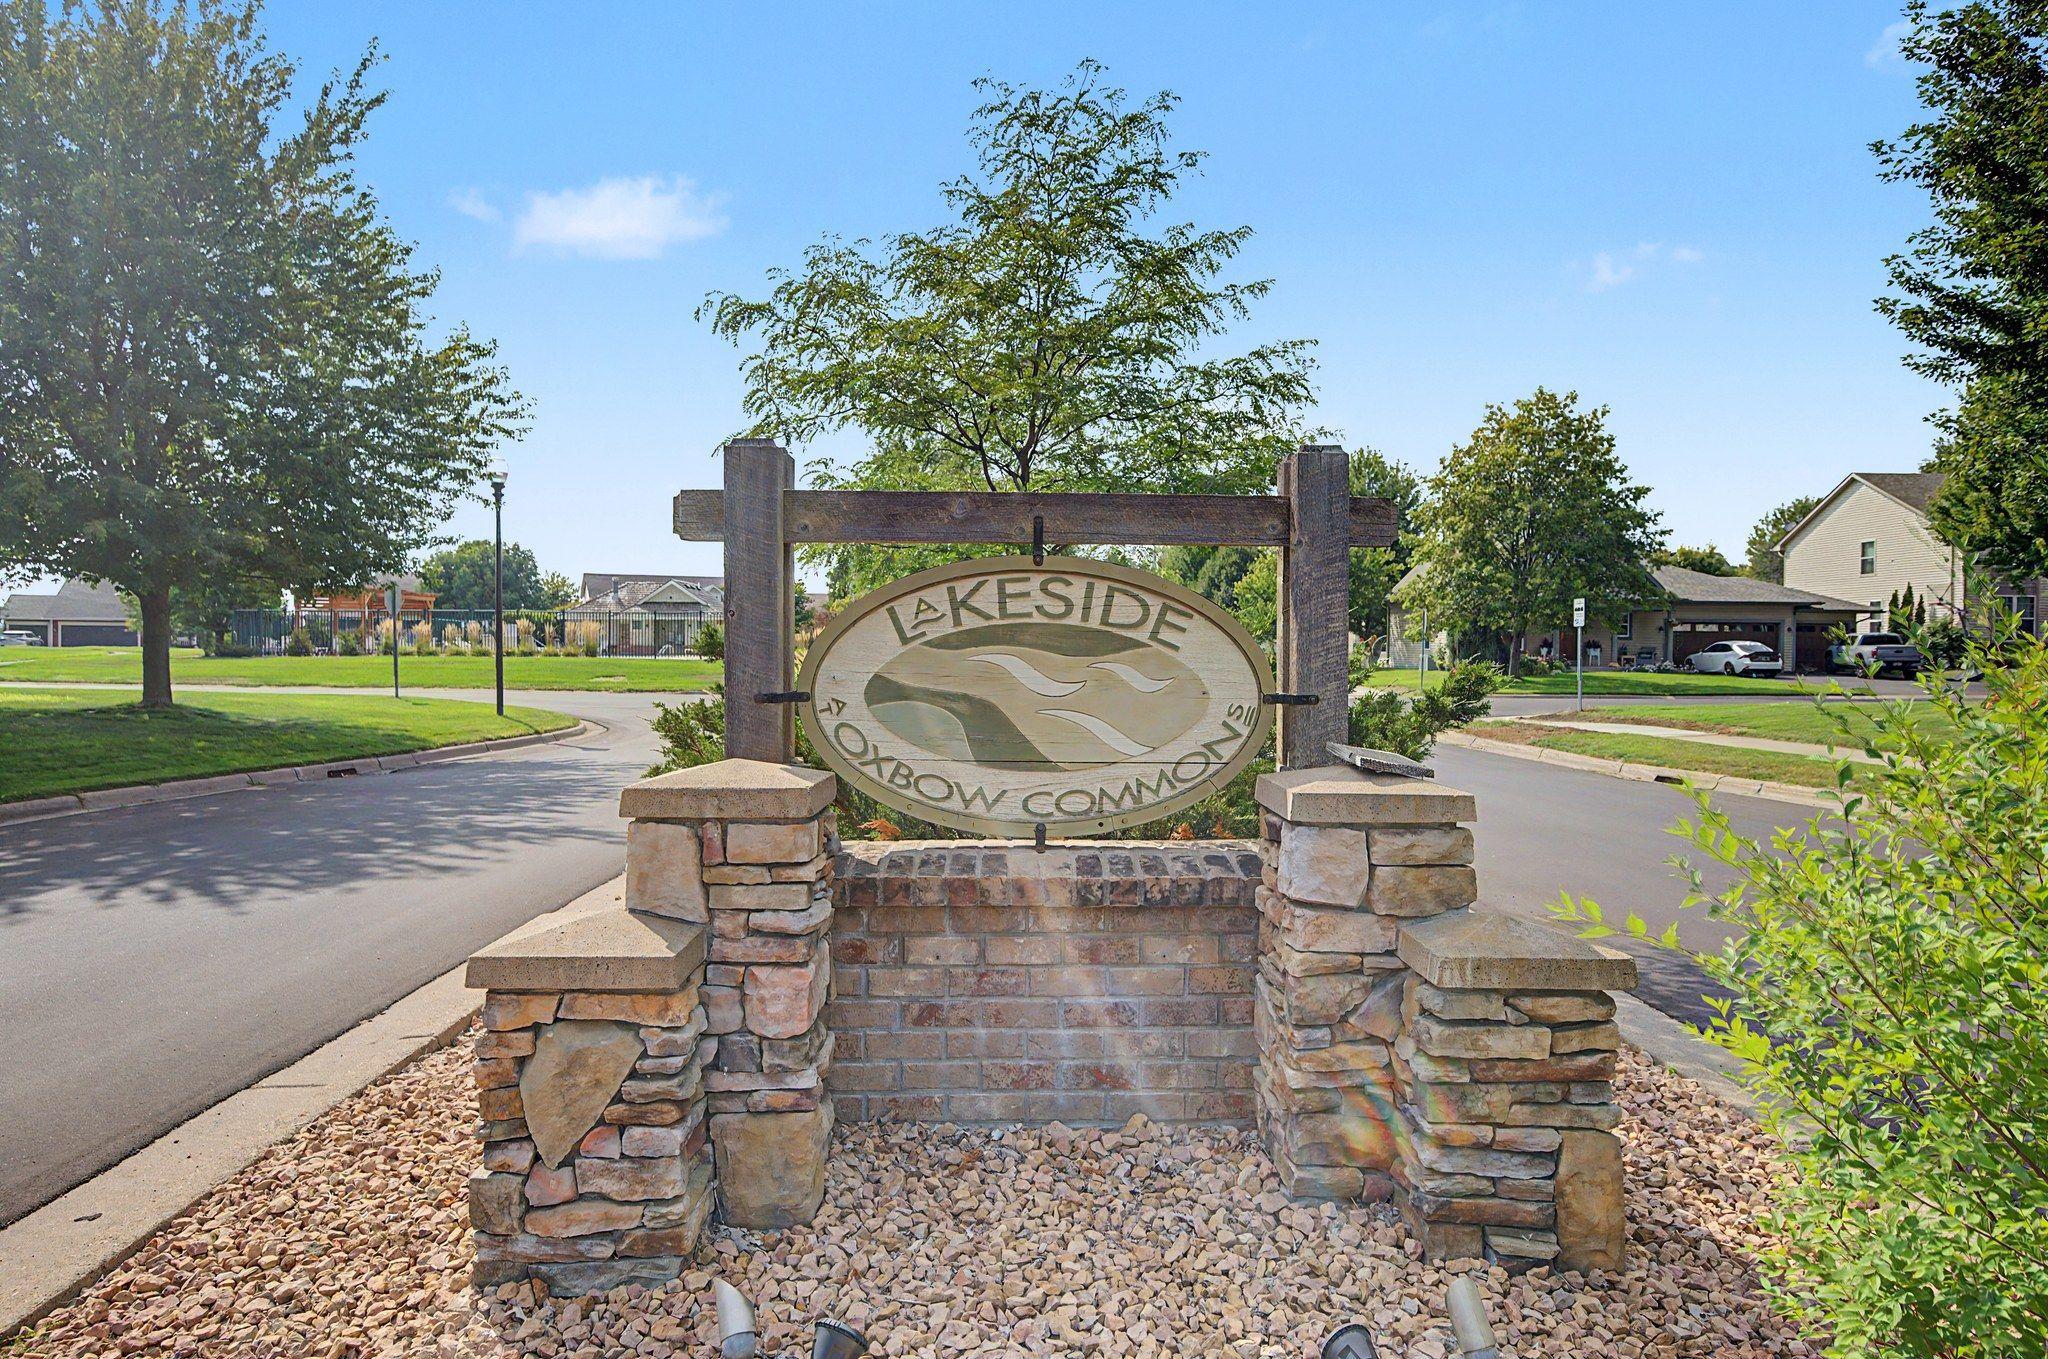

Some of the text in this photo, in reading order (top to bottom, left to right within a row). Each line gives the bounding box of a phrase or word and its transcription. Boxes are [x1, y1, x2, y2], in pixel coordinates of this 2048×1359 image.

[885, 576, 1195, 652] LAKESIDE
[818, 697, 1245, 818] AT OXBOW COMMONS
